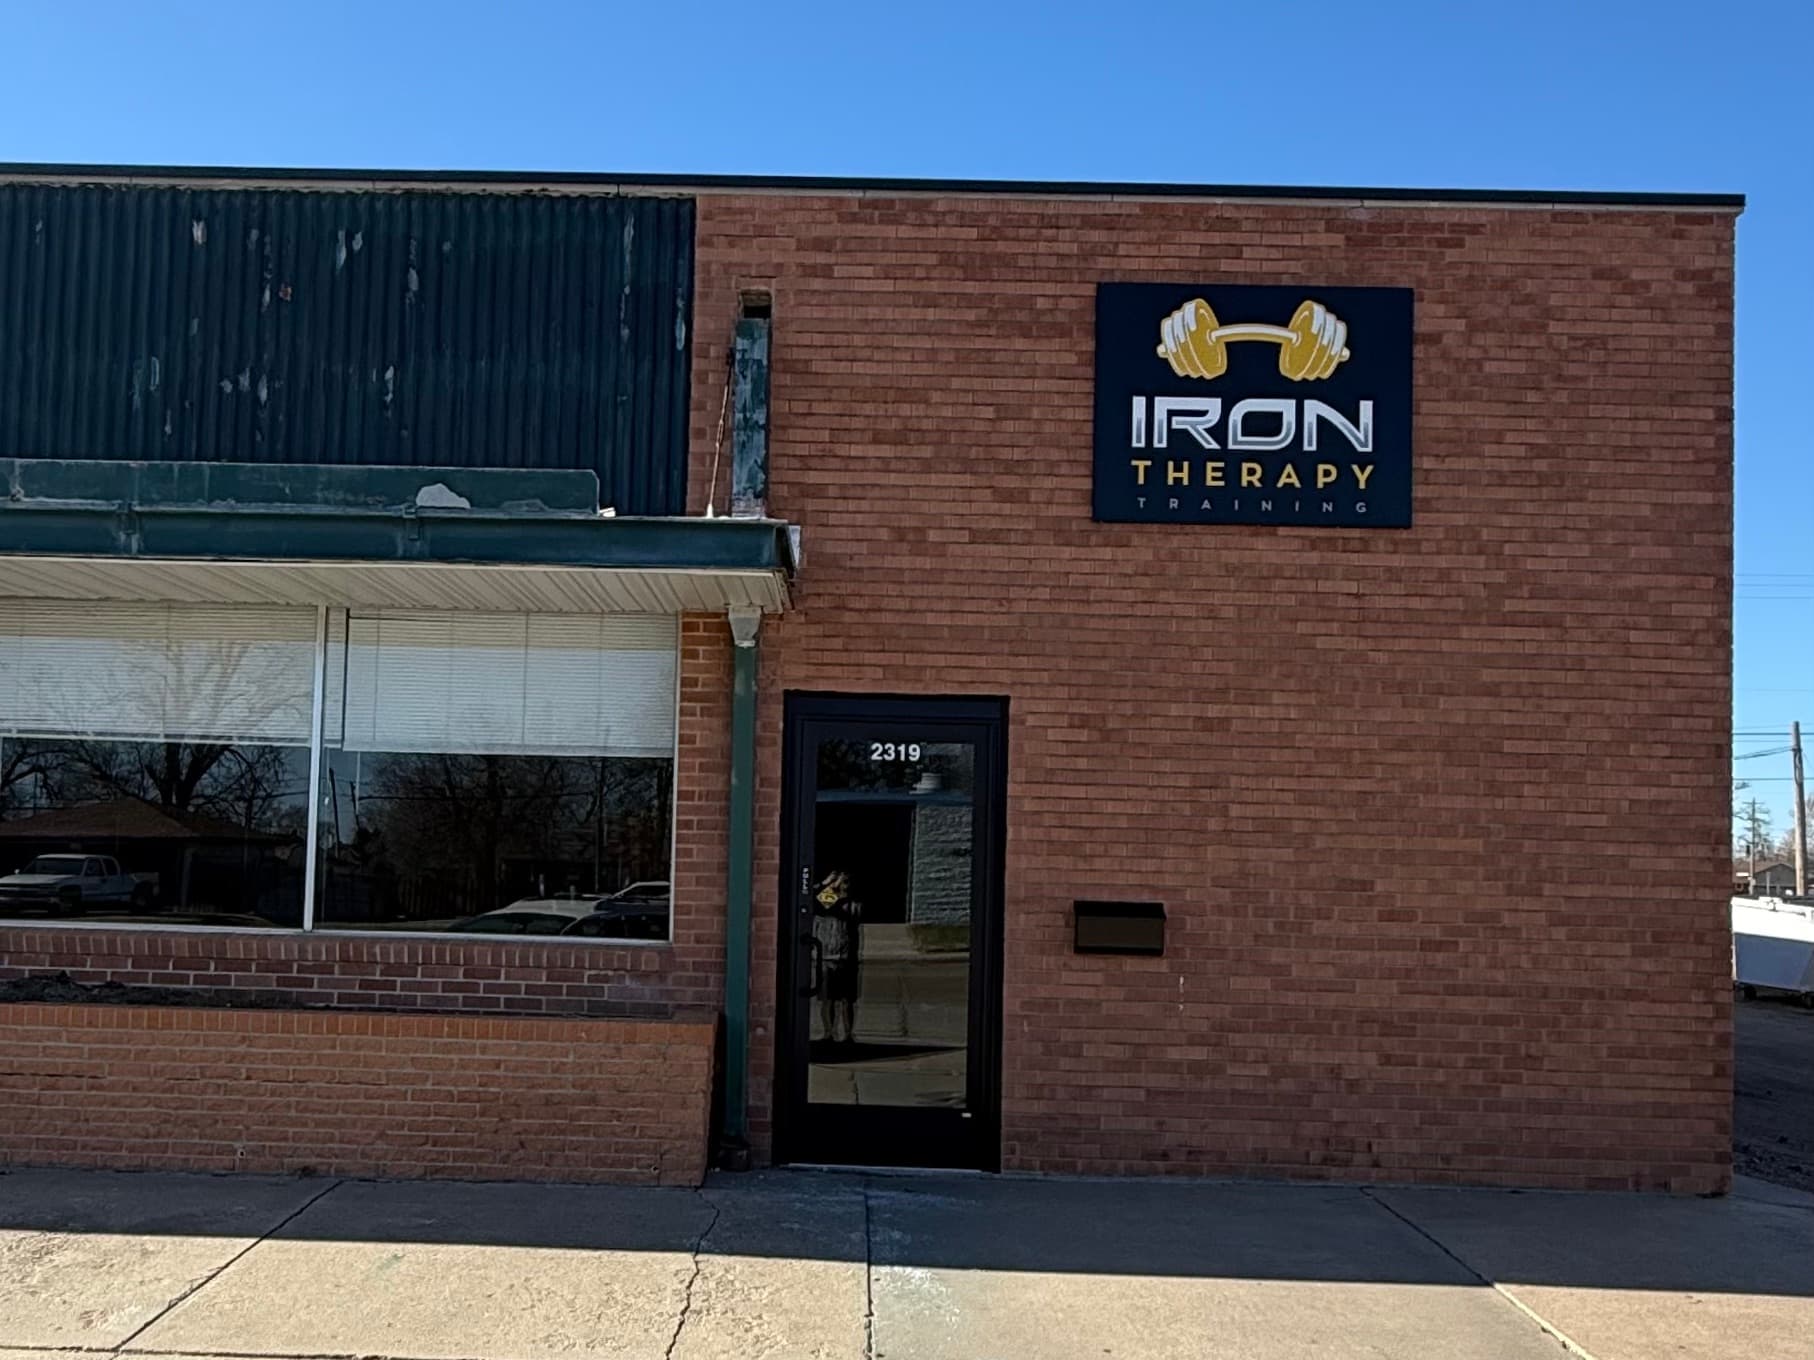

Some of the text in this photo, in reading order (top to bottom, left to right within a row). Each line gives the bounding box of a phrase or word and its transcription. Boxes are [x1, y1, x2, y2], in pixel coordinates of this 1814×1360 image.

[1131, 395, 1374, 452] IRON
[1131, 460, 1374, 489] THERAPY
[1137, 497, 1367, 513] TRAINING
[870, 742, 921, 762] 2319
